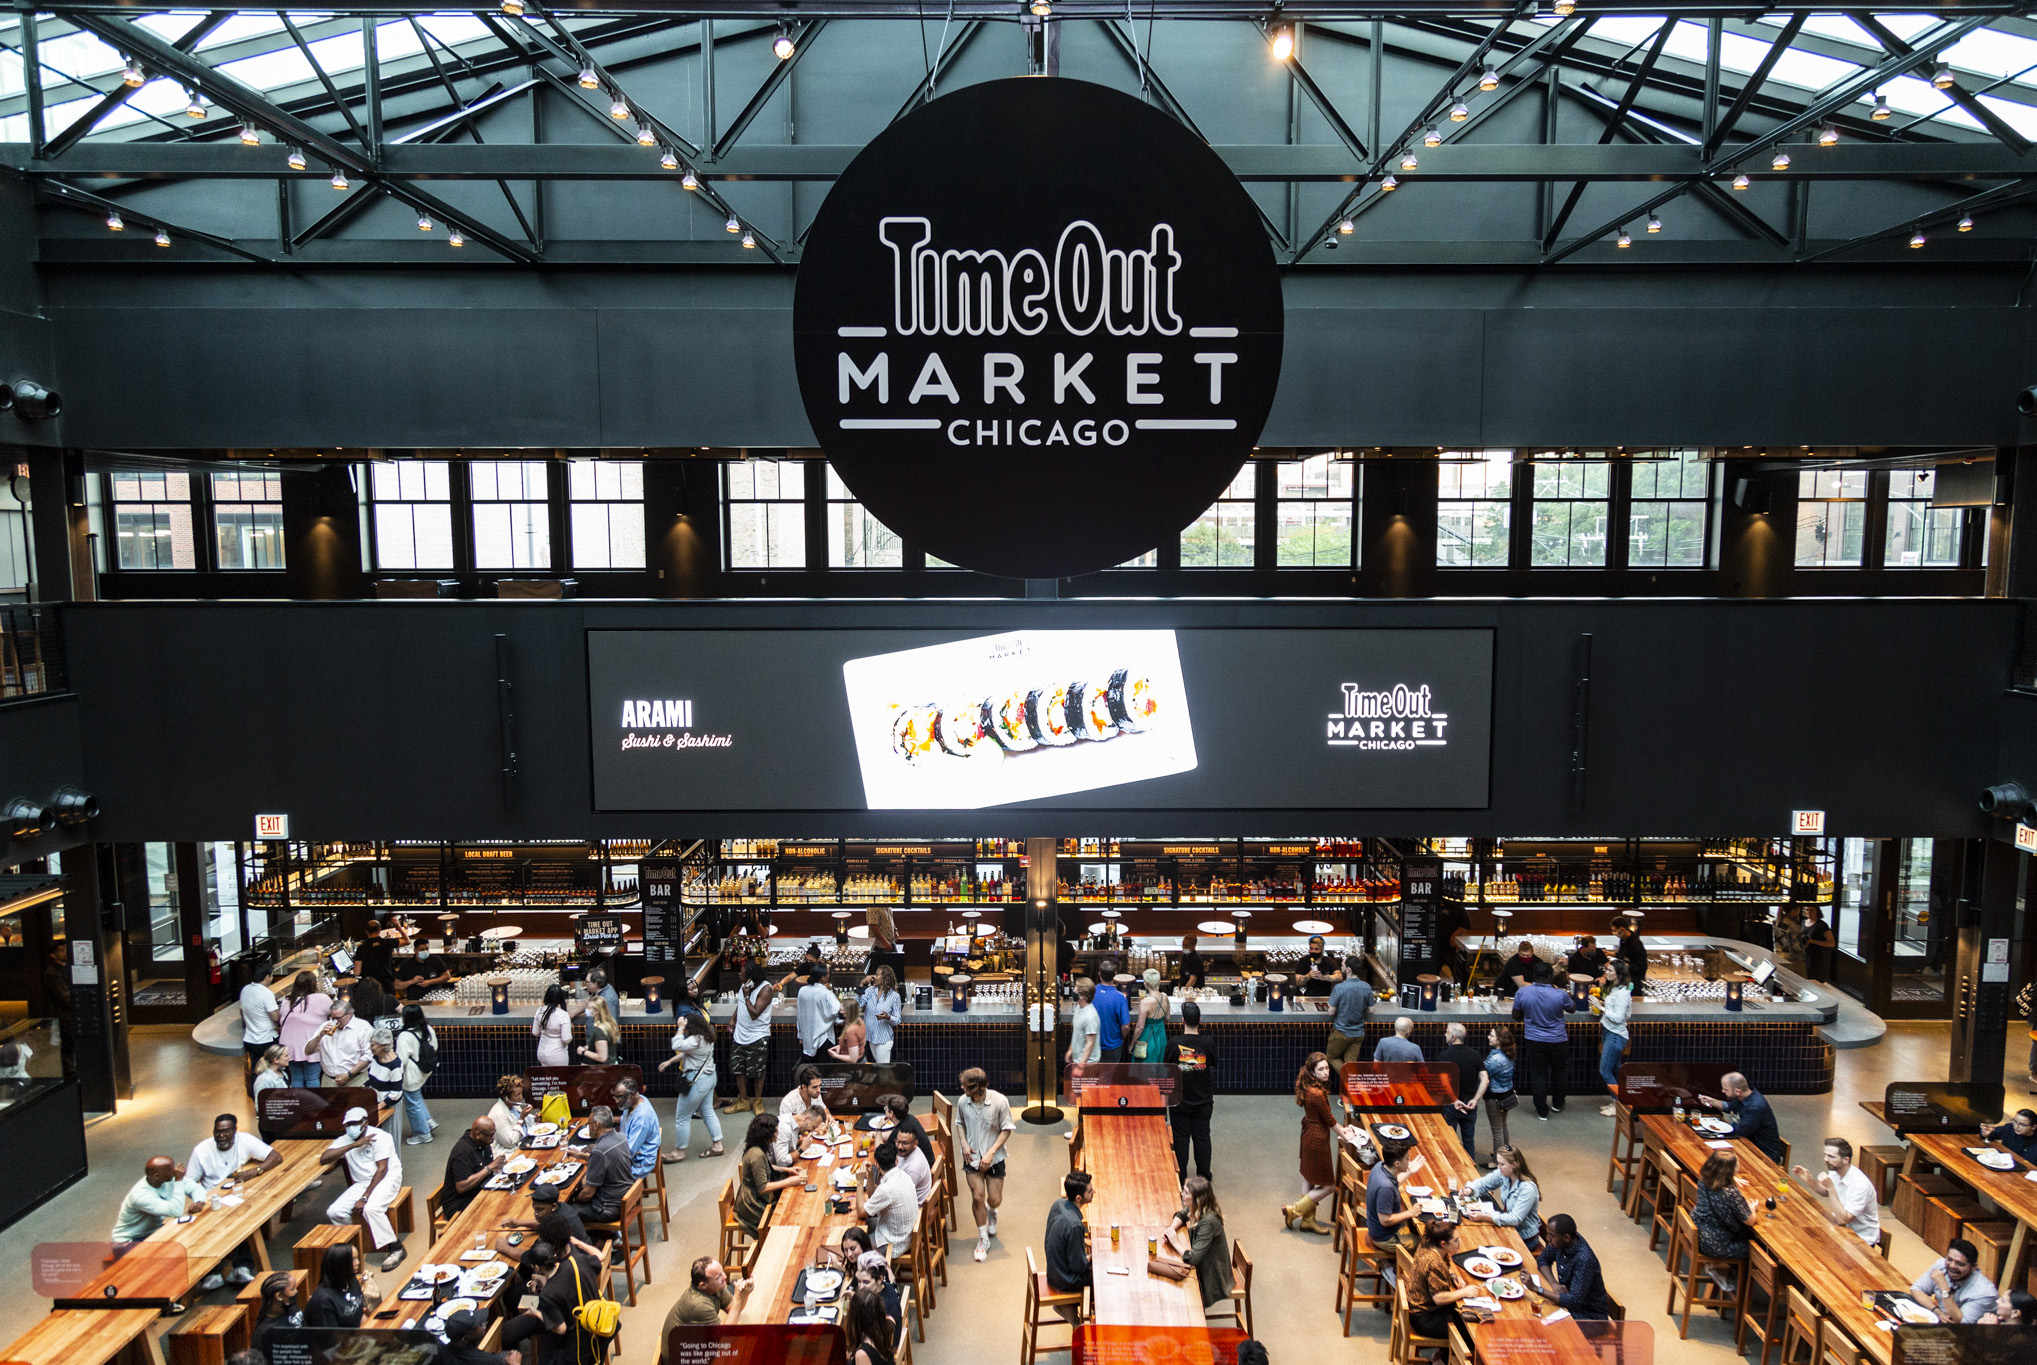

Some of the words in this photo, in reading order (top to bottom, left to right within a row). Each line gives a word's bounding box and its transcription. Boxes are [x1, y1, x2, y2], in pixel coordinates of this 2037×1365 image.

[838, 352, 1238, 405] MARKET
[947, 419, 1130, 447] CHICAGO
[621, 700, 693, 728] ARAMI
[1327, 721, 1448, 738] MARKET
[621, 732, 662, 751] Sushi
[662, 732, 676, 751] &
[676, 732, 733, 751] Sashimi
[1359, 740, 1416, 750] CHICAGO
[260, 816, 281, 831] EXIT
[1800, 812, 1820, 827] EXIT
[2019, 827, 2035, 847] EXIT
[784, 847, 826, 855] NON-ALCOHOLIC
[1163, 846, 1191, 854] SIGNATURE
[1191, 846, 1220, 854] COCKTAILS
[1269, 846, 1310, 854] NON-ALCOHOLIC
[1594, 846, 1608, 854] WINE
[649, 884, 671, 897] BAR
[1410, 882, 1432, 895] BAR
[602, 920, 613, 928] OUT
[680, 1342, 700, 1350] "Going
[700, 1342, 707, 1350] to
[708, 1342, 731, 1350] Chicago
